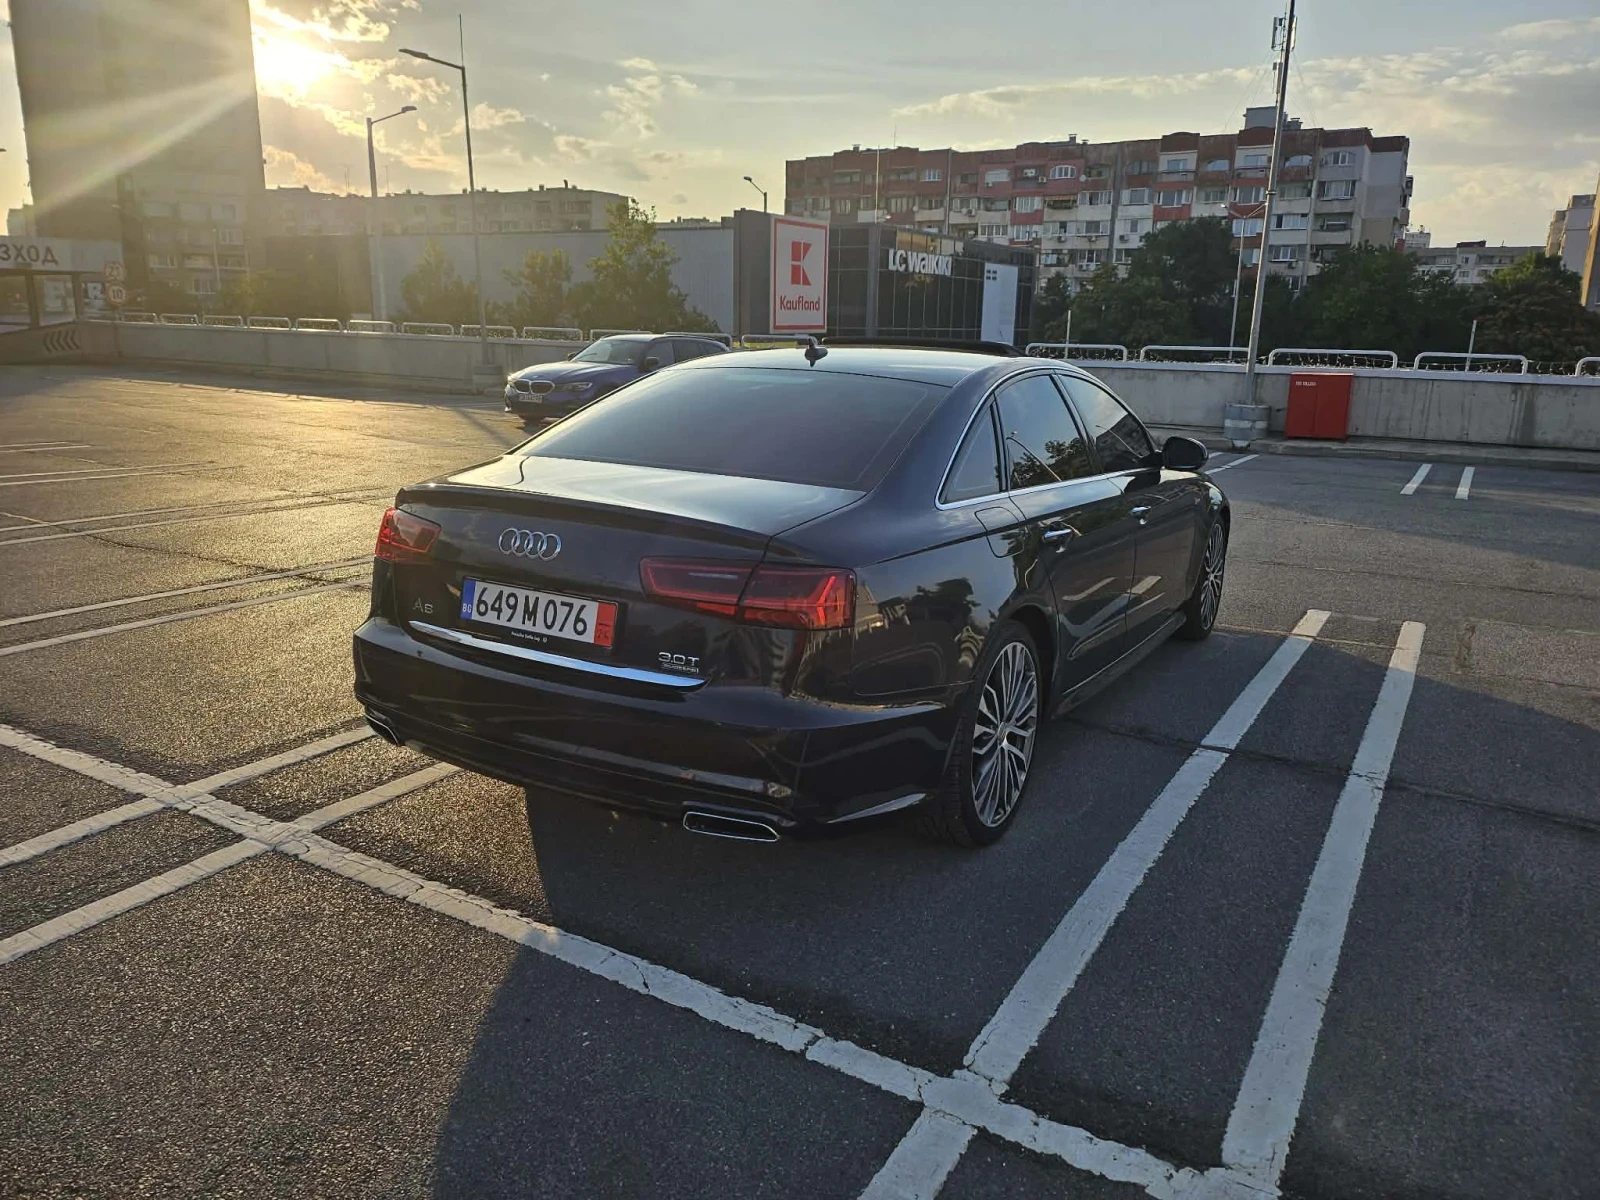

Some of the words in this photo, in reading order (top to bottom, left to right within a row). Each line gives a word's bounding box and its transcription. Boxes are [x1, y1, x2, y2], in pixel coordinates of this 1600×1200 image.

[888, 248, 906, 272] LC
[112, 288, 123, 300] 10
[779, 295, 821, 312] Kaufland
[462, 603, 472, 613] BG
